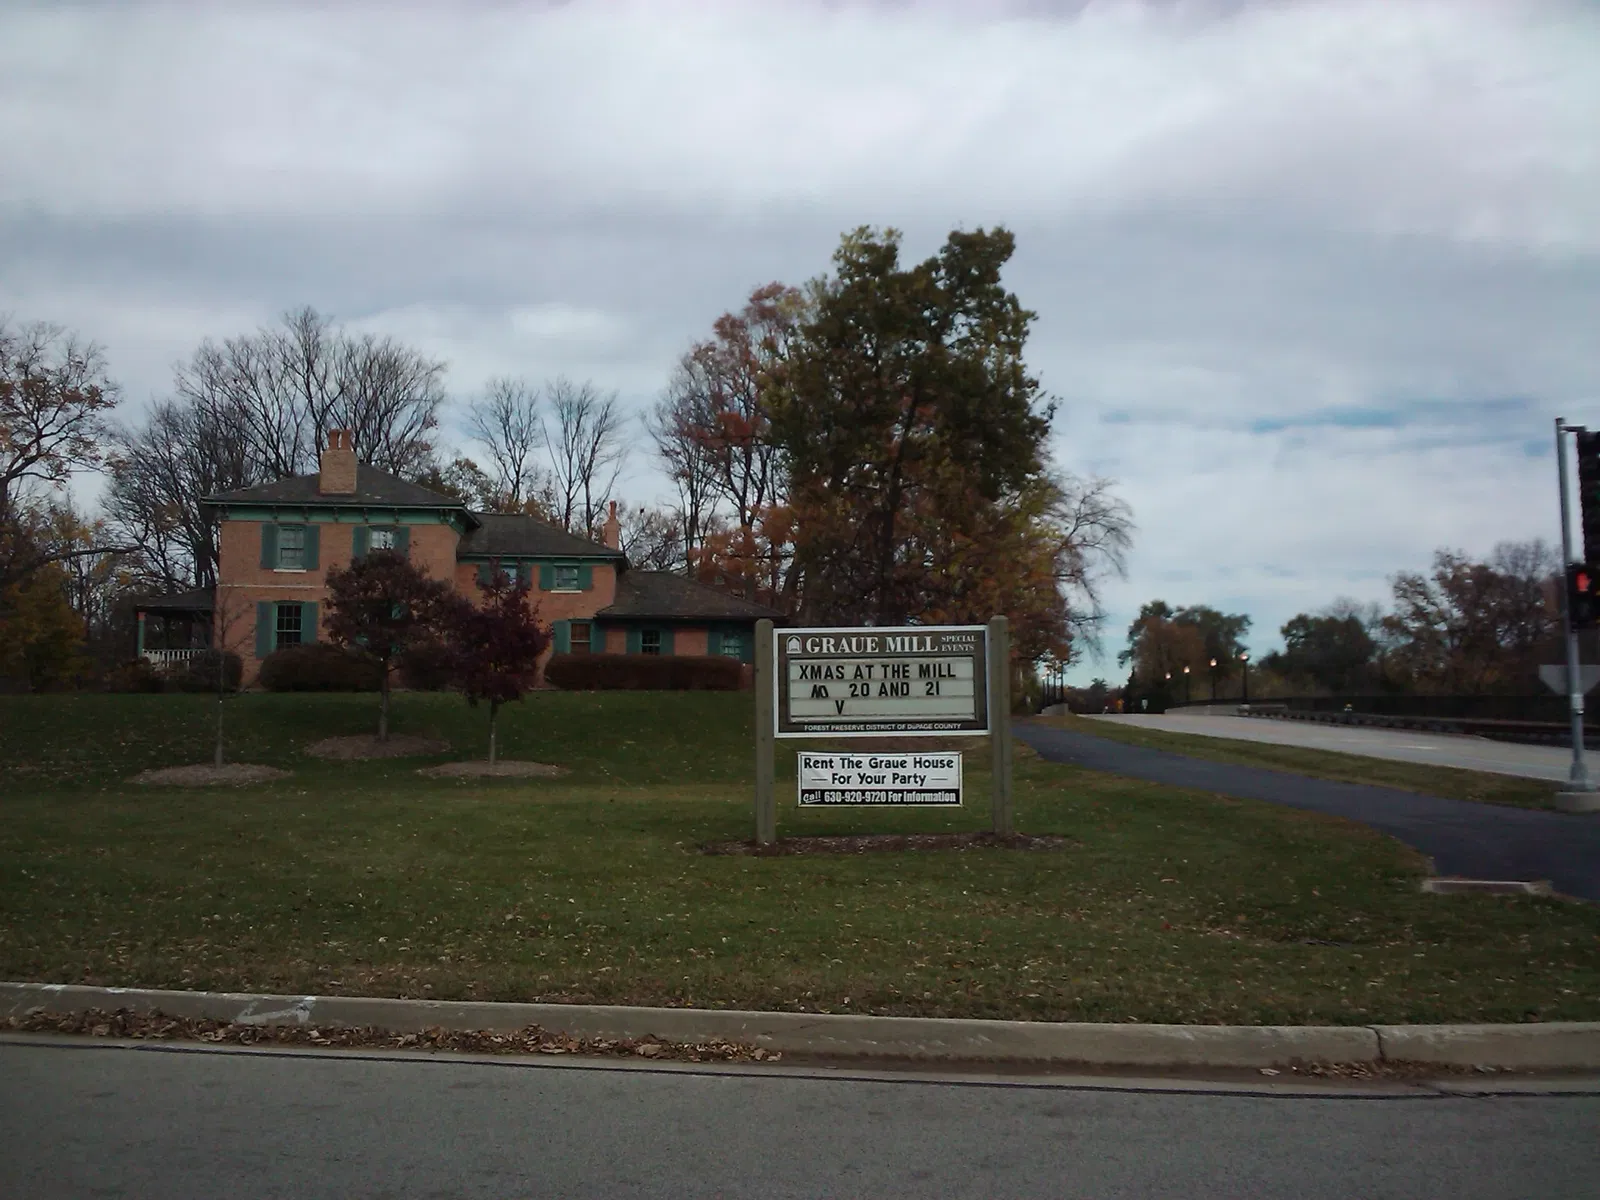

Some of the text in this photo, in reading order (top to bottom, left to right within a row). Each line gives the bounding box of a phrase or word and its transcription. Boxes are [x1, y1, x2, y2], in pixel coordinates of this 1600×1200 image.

[806, 636, 938, 654] GRAUE MILL
[799, 663, 956, 680] XMAS AT THE MILL
[849, 682, 870, 698] 20
[878, 682, 910, 696] AND
[925, 681, 940, 696] 21
[835, 700, 845, 715] V
[804, 757, 954, 769] Rent The Graue House
[832, 773, 926, 787] For Your Party
[803, 791, 956, 803] Call 630-920-9720 For Information
